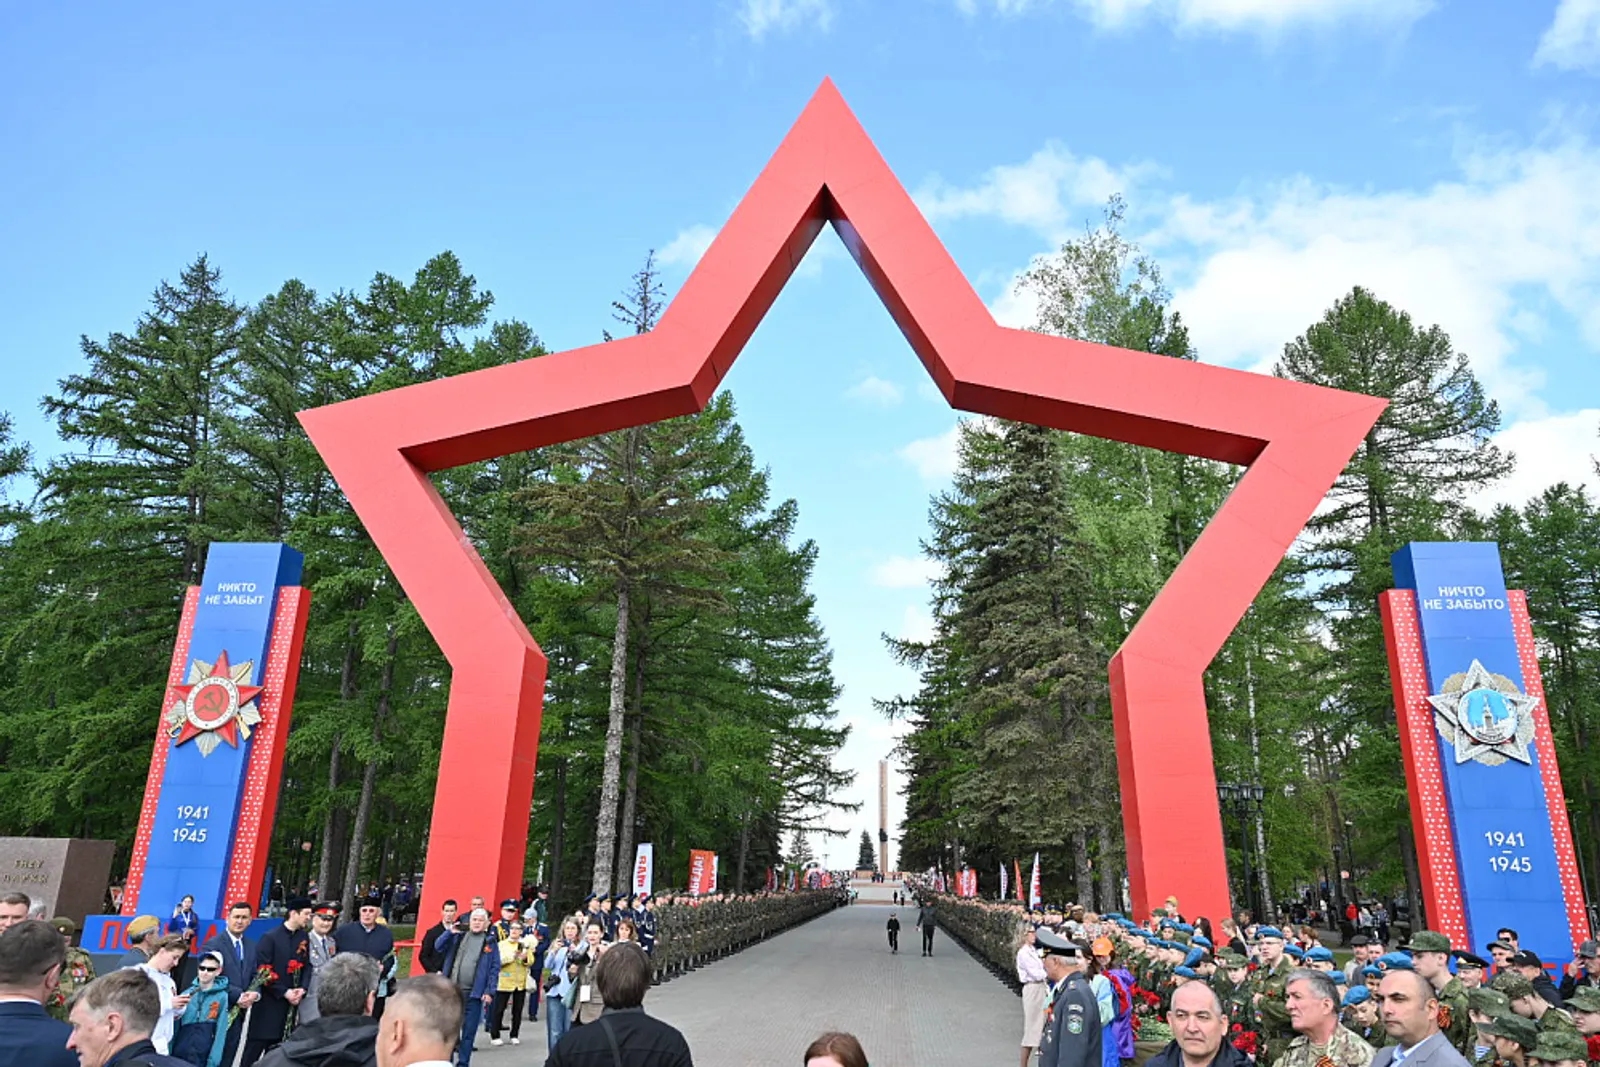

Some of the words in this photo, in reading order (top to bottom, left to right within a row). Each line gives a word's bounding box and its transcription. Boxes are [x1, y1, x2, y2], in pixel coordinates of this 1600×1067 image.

[217, 582, 257, 593] НИКТО
[1437, 585, 1486, 597] НИЧТО
[204, 594, 221, 605] НЕ
[223, 594, 265, 605] ЗАБЫТ
[1423, 598, 1443, 610] НЕ
[1446, 598, 1505, 610] ЗАБЫТО
[177, 805, 209, 820] 1941
[172, 827, 208, 843] 1945
[1484, 830, 1526, 847] 1941
[1489, 856, 1533, 873] 1945
